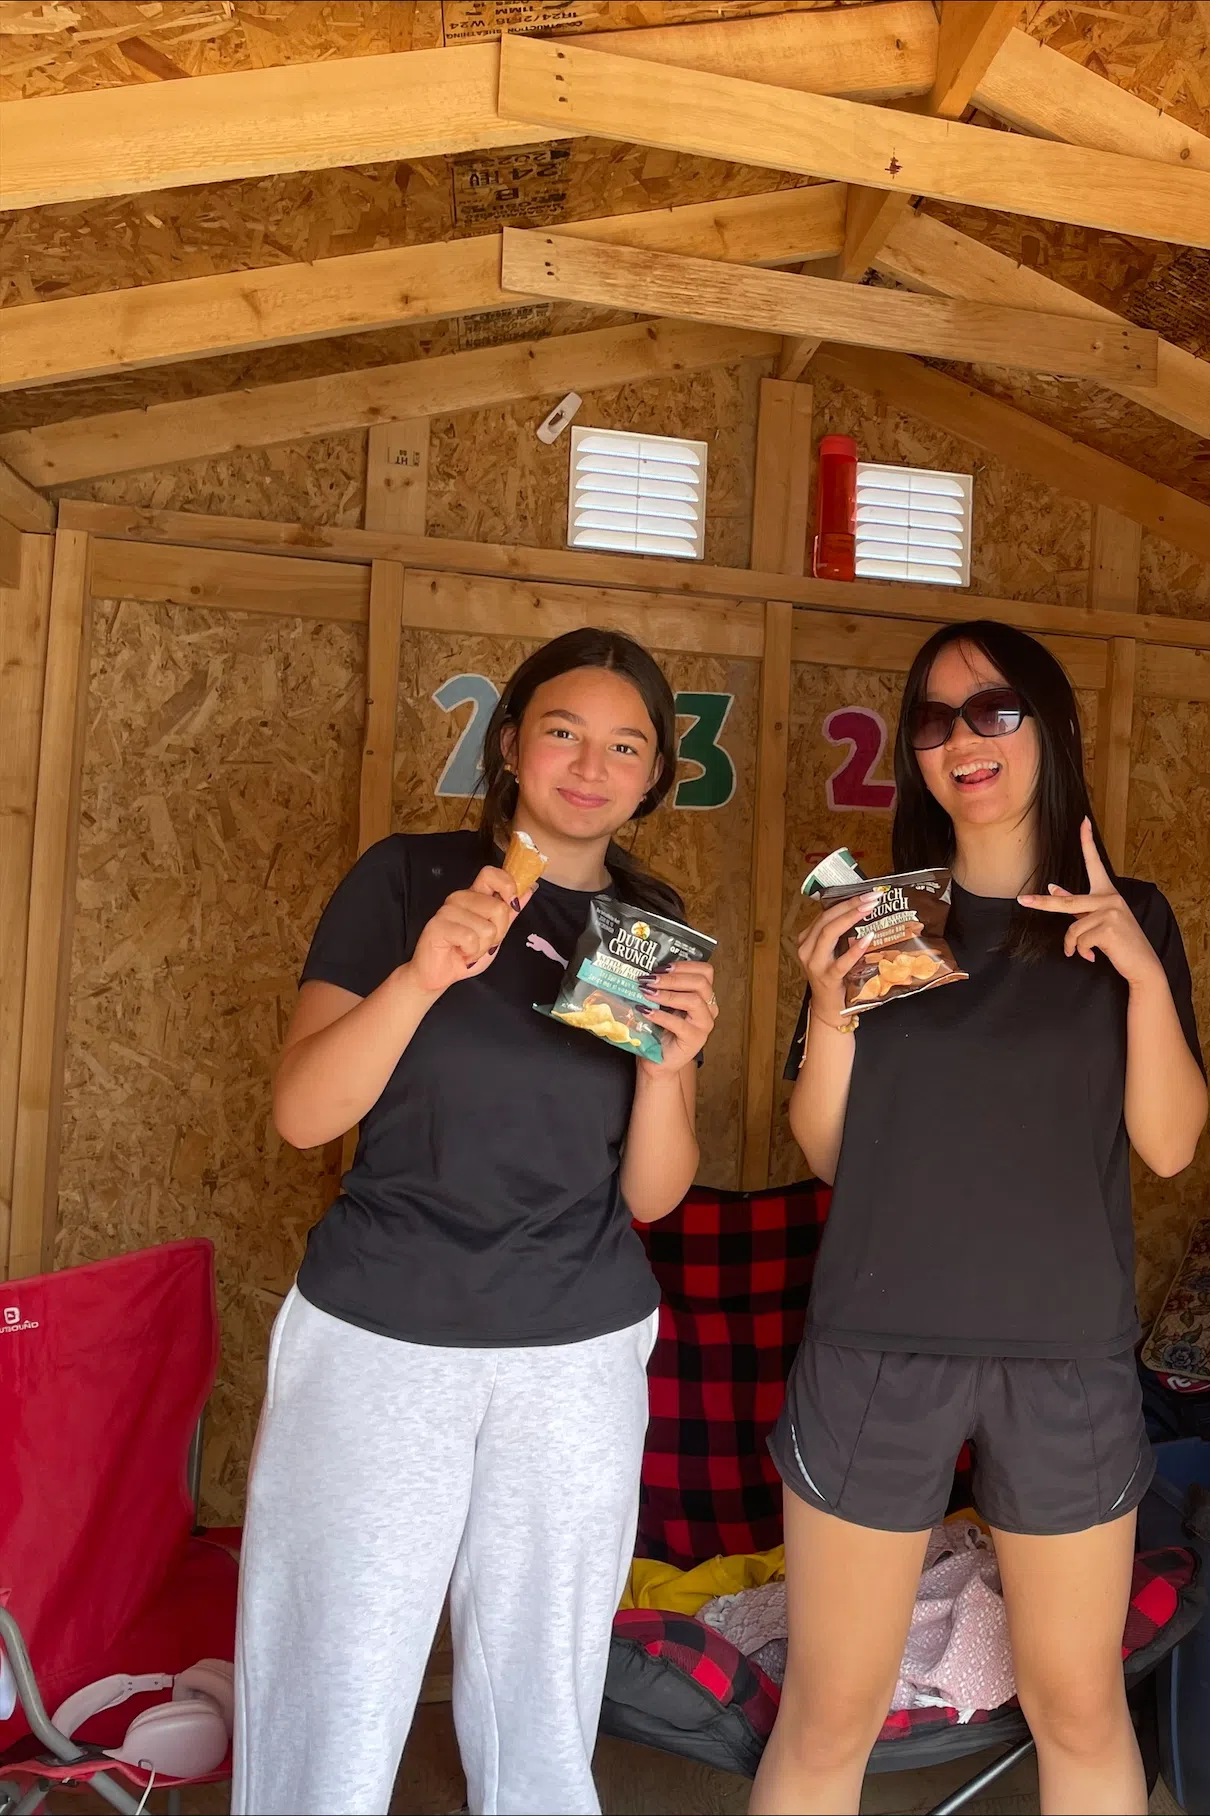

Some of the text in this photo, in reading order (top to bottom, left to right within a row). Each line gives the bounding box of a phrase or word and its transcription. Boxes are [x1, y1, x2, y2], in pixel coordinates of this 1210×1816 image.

[608, 937, 658, 971] CRUNCH
[617, 927, 658, 957] DUTCH
[0, 1321, 39, 1333] UTBOUND
